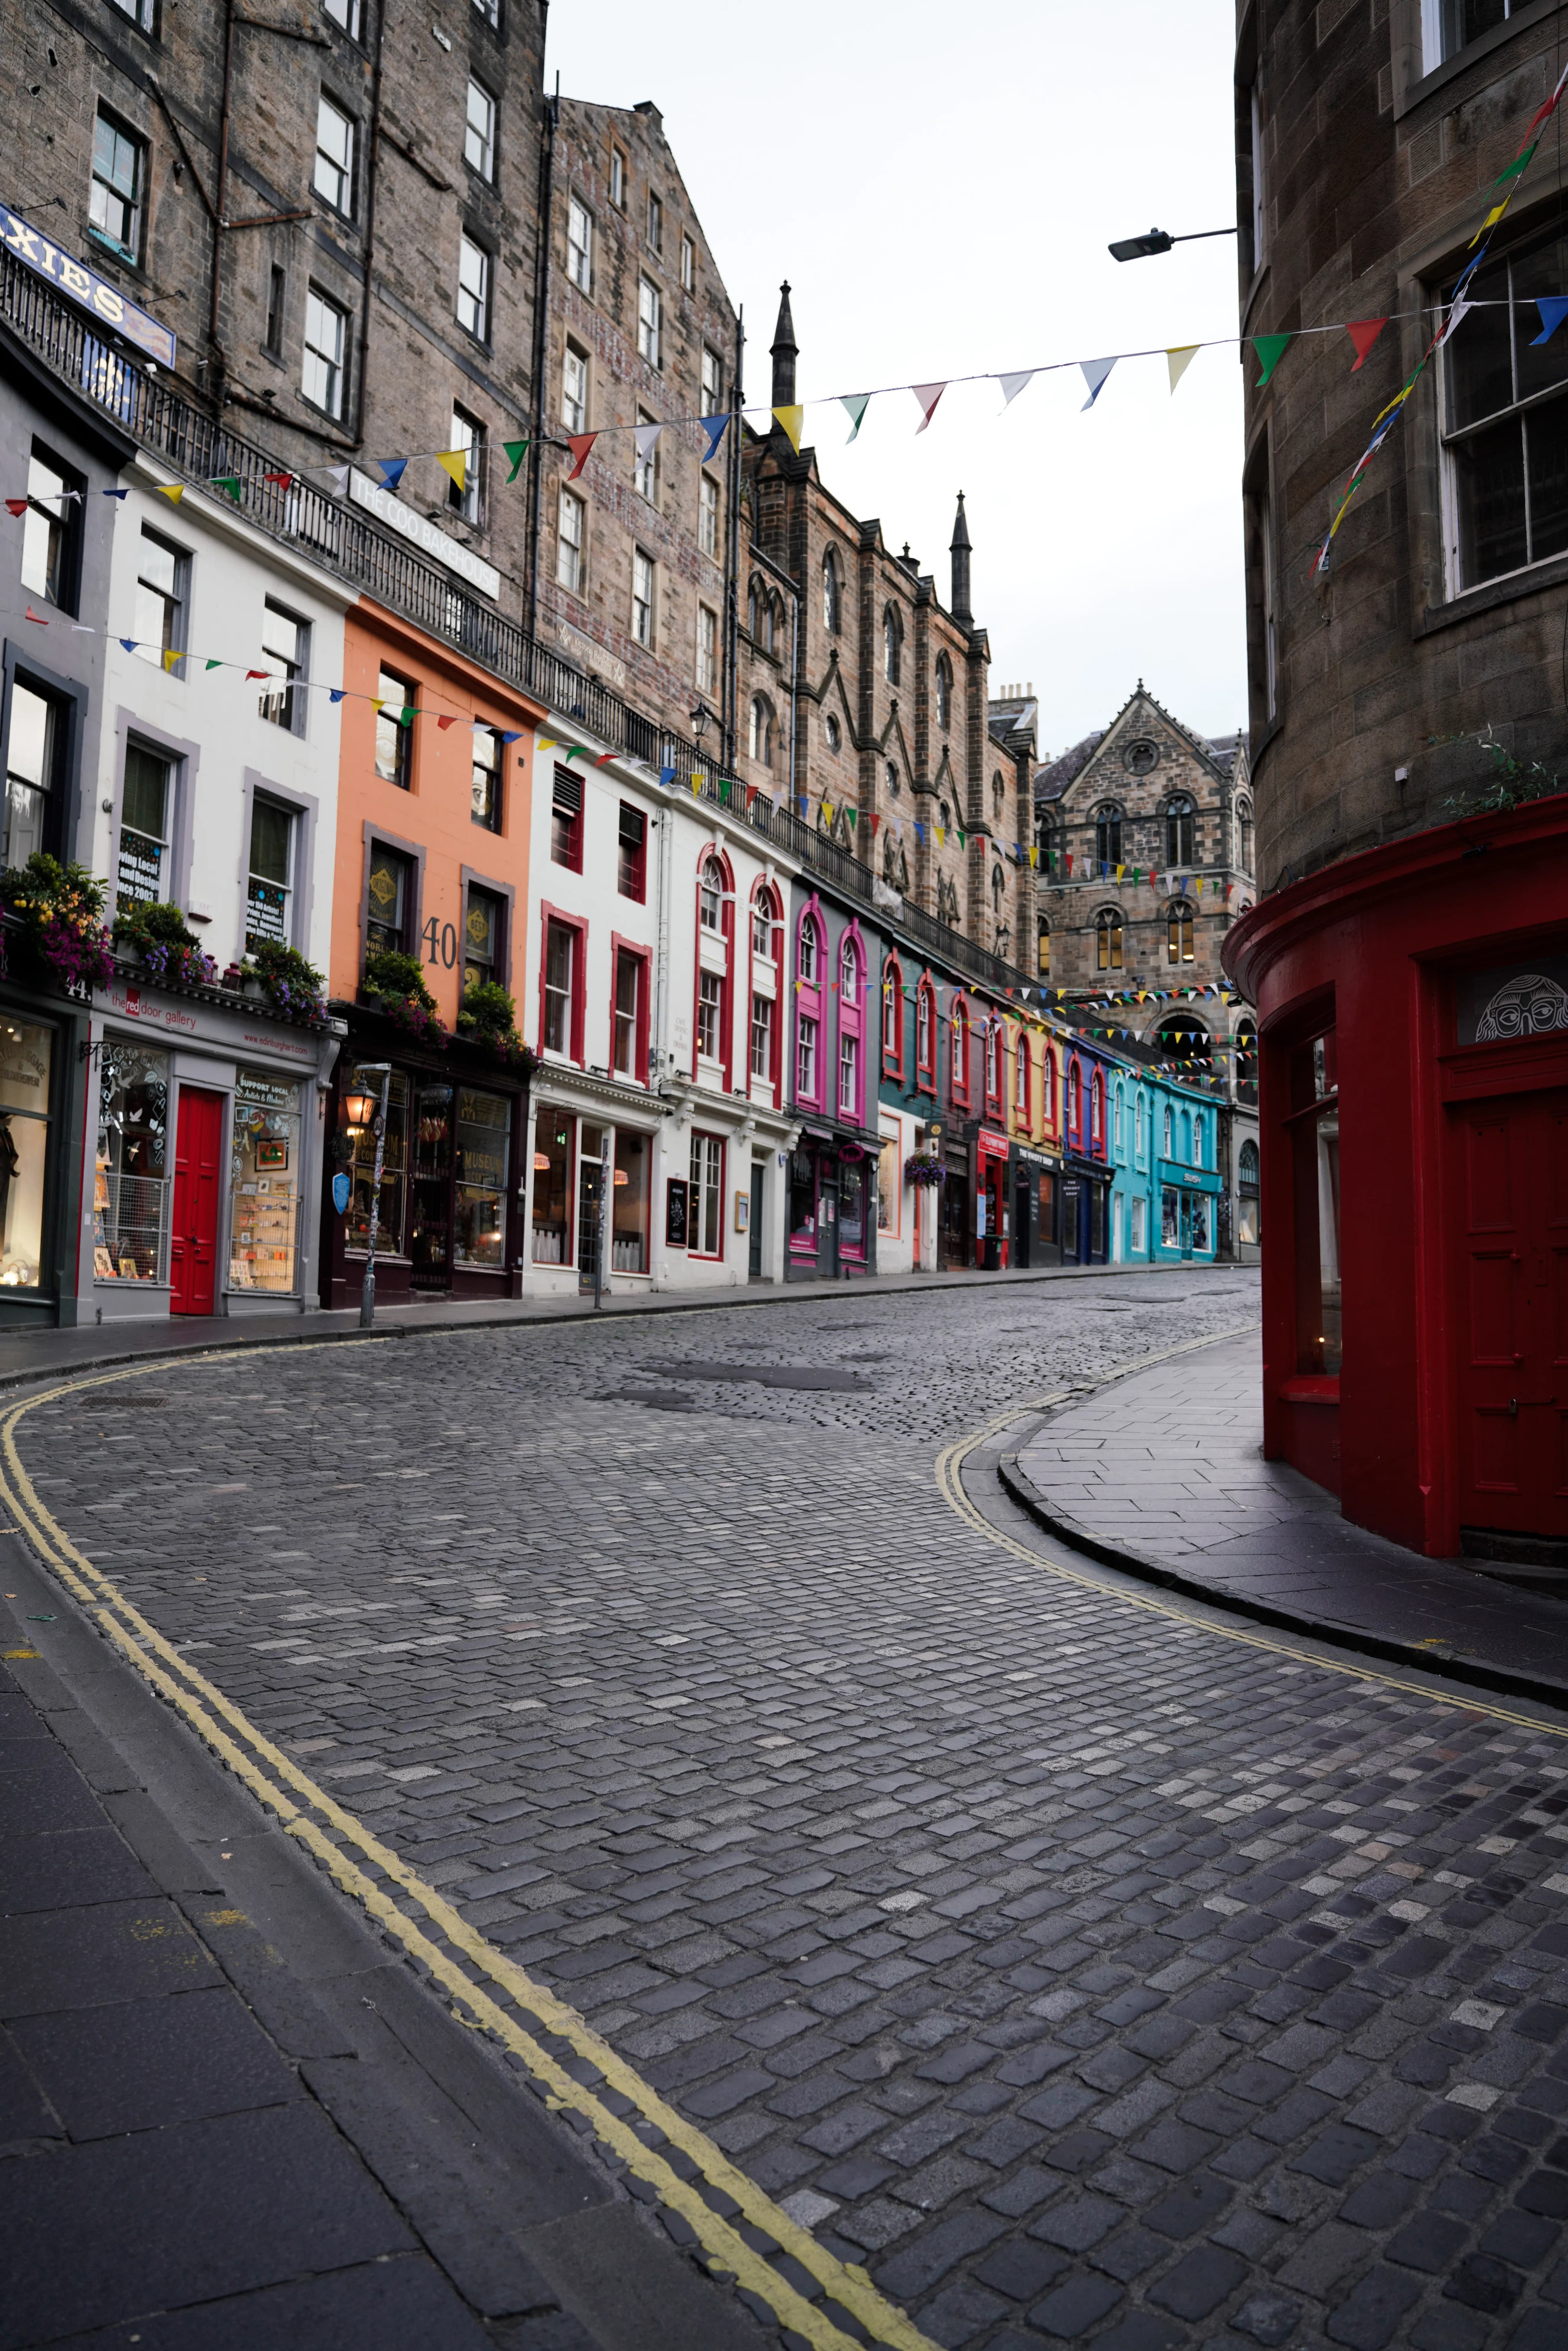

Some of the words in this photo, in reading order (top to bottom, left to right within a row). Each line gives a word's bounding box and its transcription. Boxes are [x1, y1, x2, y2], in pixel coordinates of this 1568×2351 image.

[0, 216, 123, 323] XIES
[354, 475, 385, 514] THE
[388, 500, 419, 537] COO
[423, 524, 497, 594] BAKEHOUSE
[120, 867, 135, 881] and
[138, 857, 158, 875] Local
[471, 919, 485, 933] BEST
[422, 917, 457, 969] 40
[112, 993, 125, 1008] the
[127, 999, 139, 1012] red
[141, 1001, 162, 1018] door
[166, 1009, 196, 1030] gallery
[240, 1079, 270, 1092] SUPPORT
[272, 1086, 289, 1095] LOCAL
[365, 1104, 373, 1115] 40
[465, 1150, 503, 1173] MUSEUM
[1043, 1156, 1053, 1166] SHOP
